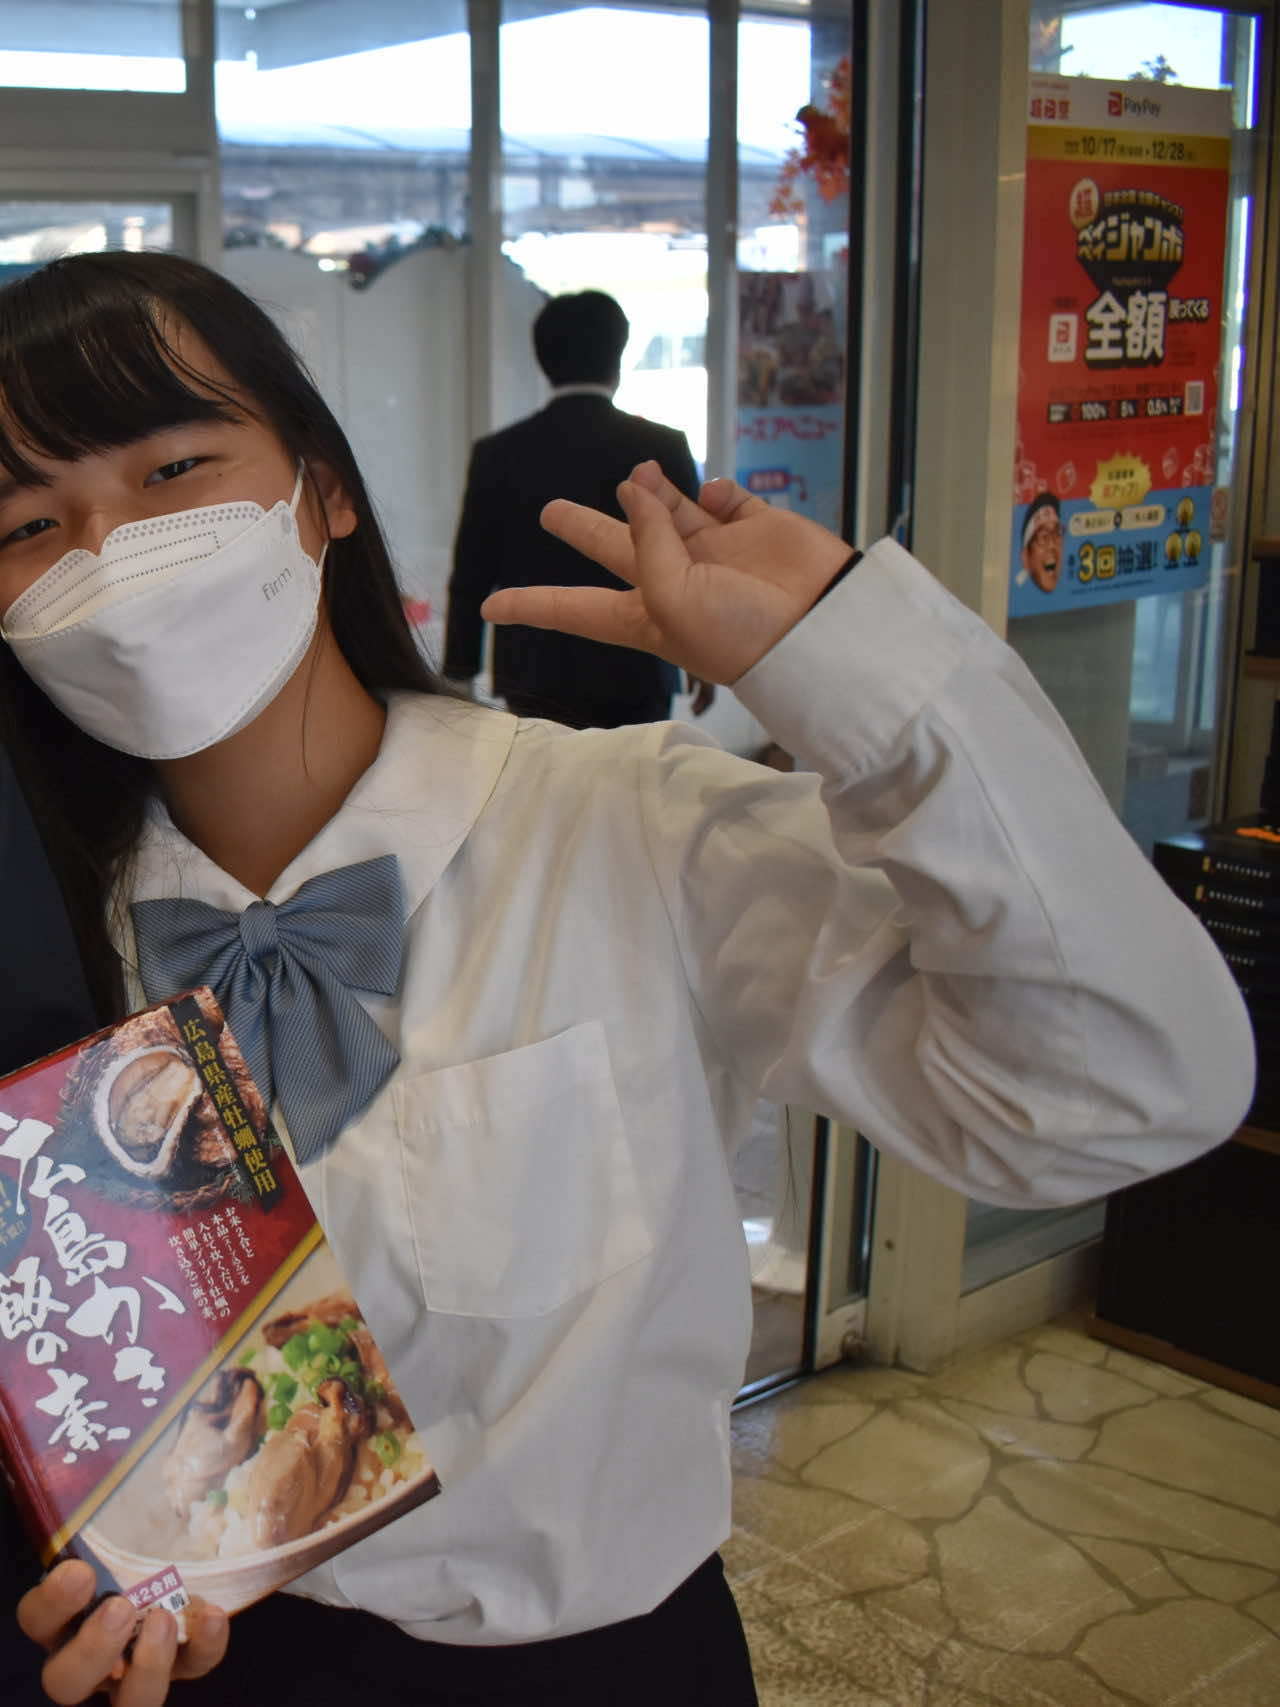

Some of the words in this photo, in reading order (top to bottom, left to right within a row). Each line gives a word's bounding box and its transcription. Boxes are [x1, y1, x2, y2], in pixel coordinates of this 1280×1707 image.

[1086, 290, 1168, 361] 全額
[262, 567, 292, 601] firm
[183, 1018, 277, 1196] 広島県産牡蠣使用
